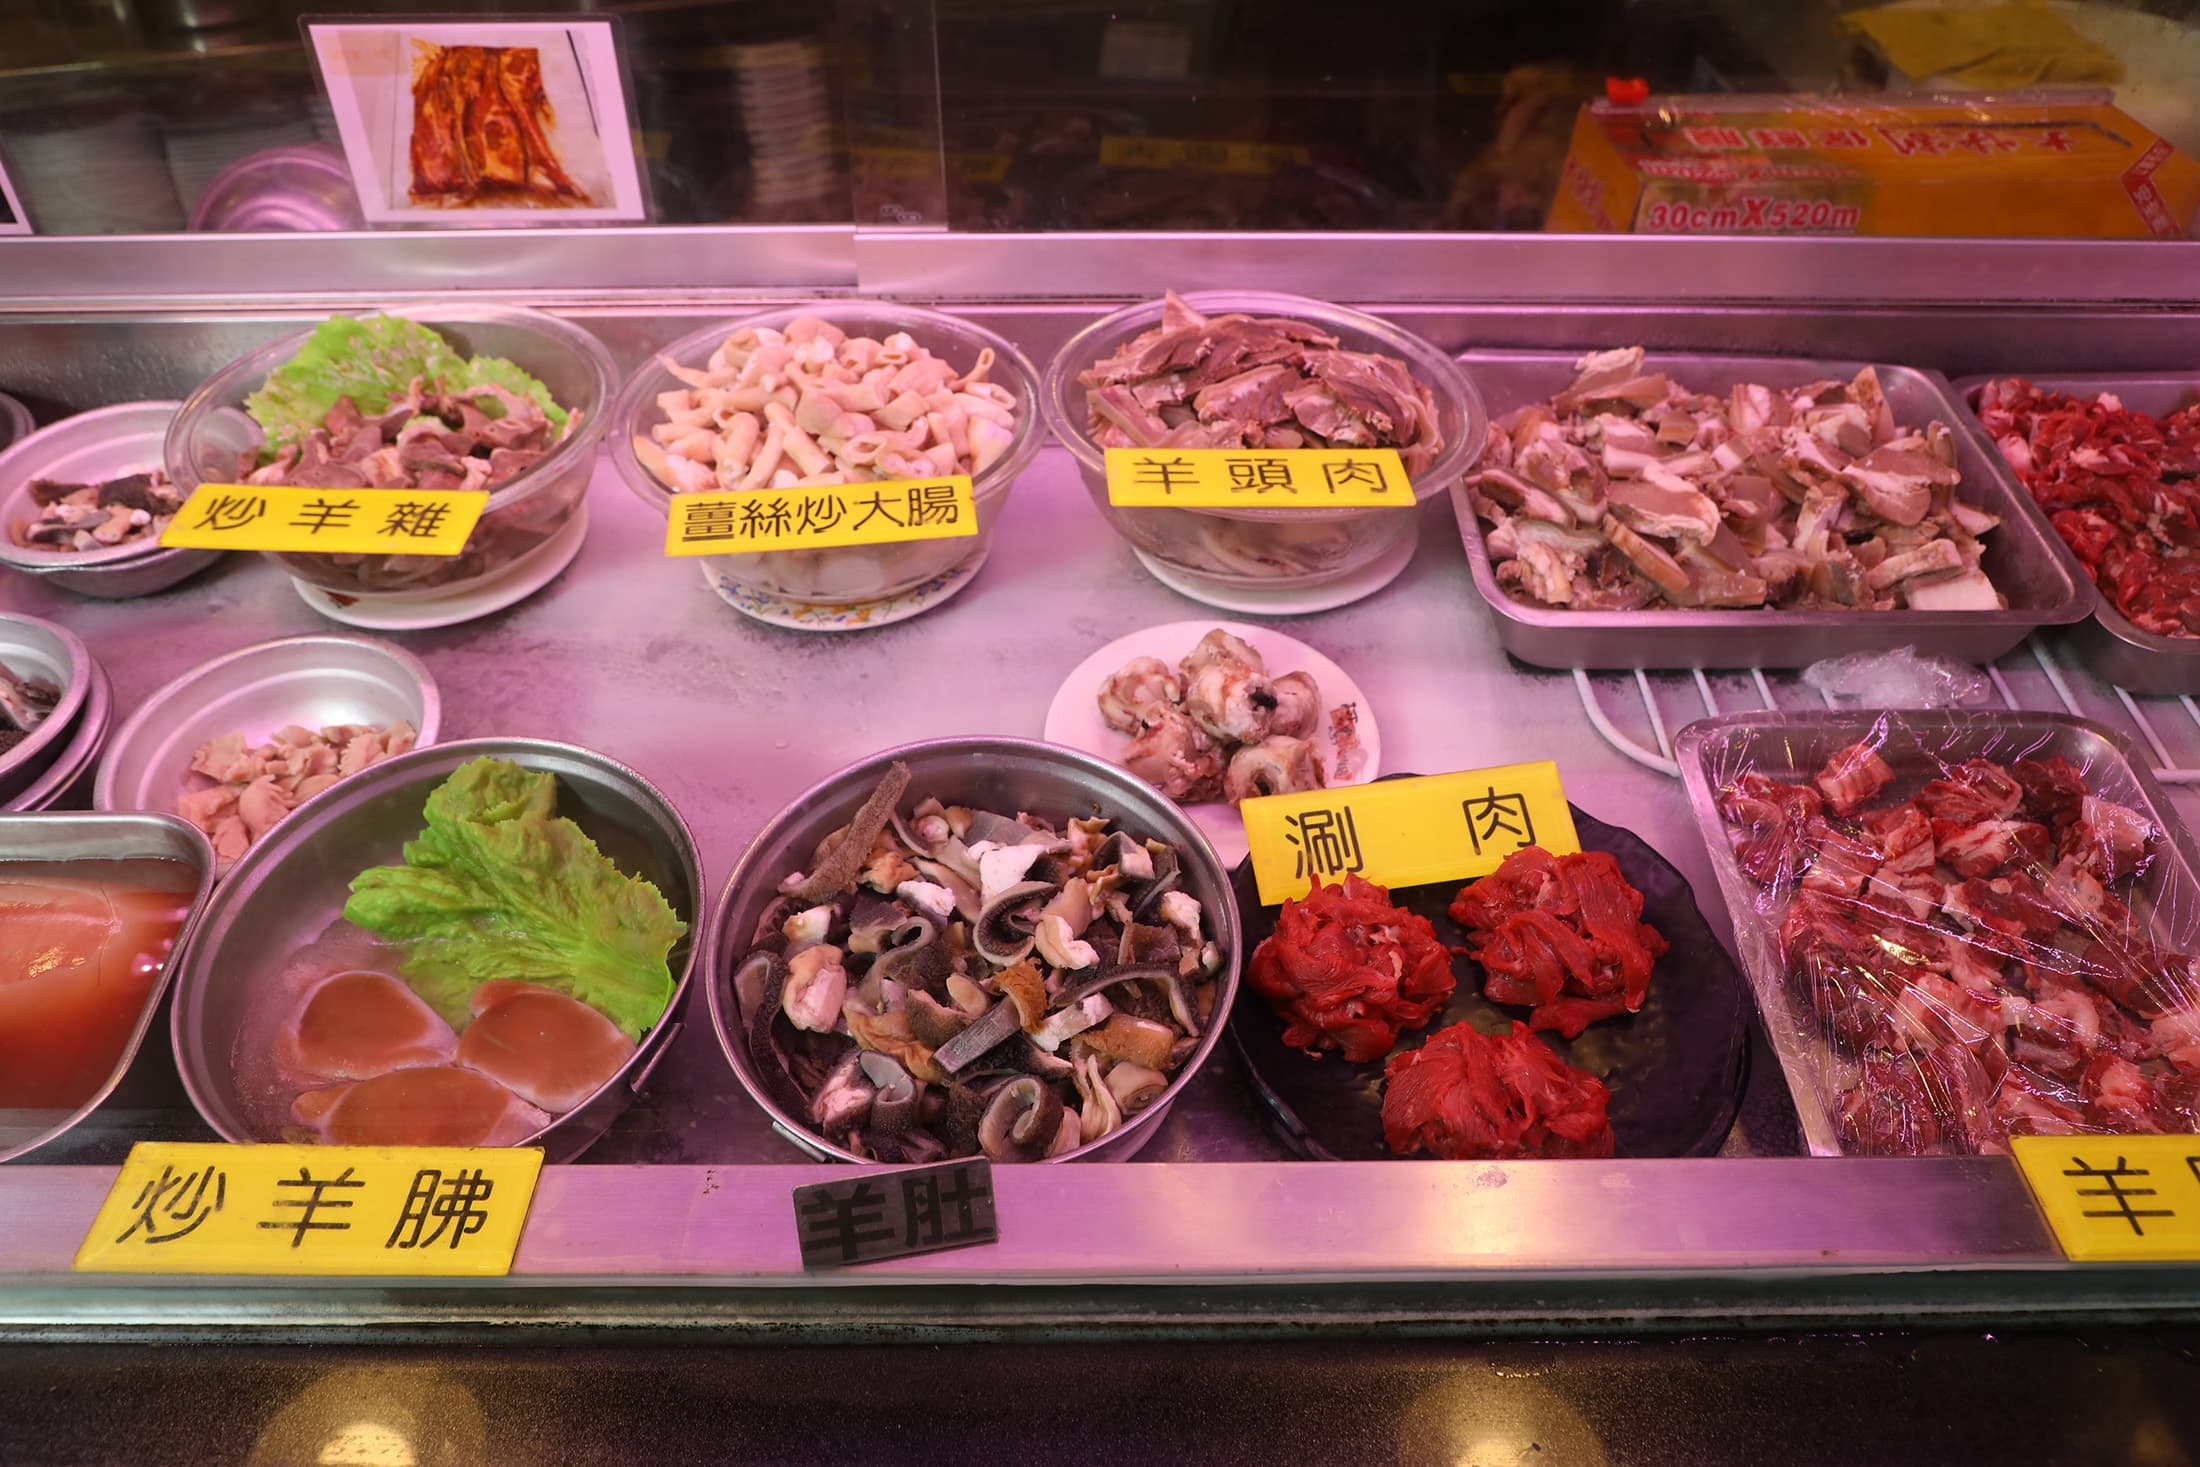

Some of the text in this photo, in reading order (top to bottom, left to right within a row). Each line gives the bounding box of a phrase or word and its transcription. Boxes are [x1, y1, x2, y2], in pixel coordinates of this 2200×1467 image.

[1132, 457, 1389, 494] 羊頭肉
[192, 495, 452, 538] 炒羊雜
[682, 485, 959, 542] 薑絲炒大腸
[1285, 787, 1537, 879] 涮肉
[801, 1168, 994, 1260] 羊肚
[2063, 1156, 2200, 1236] 羊
